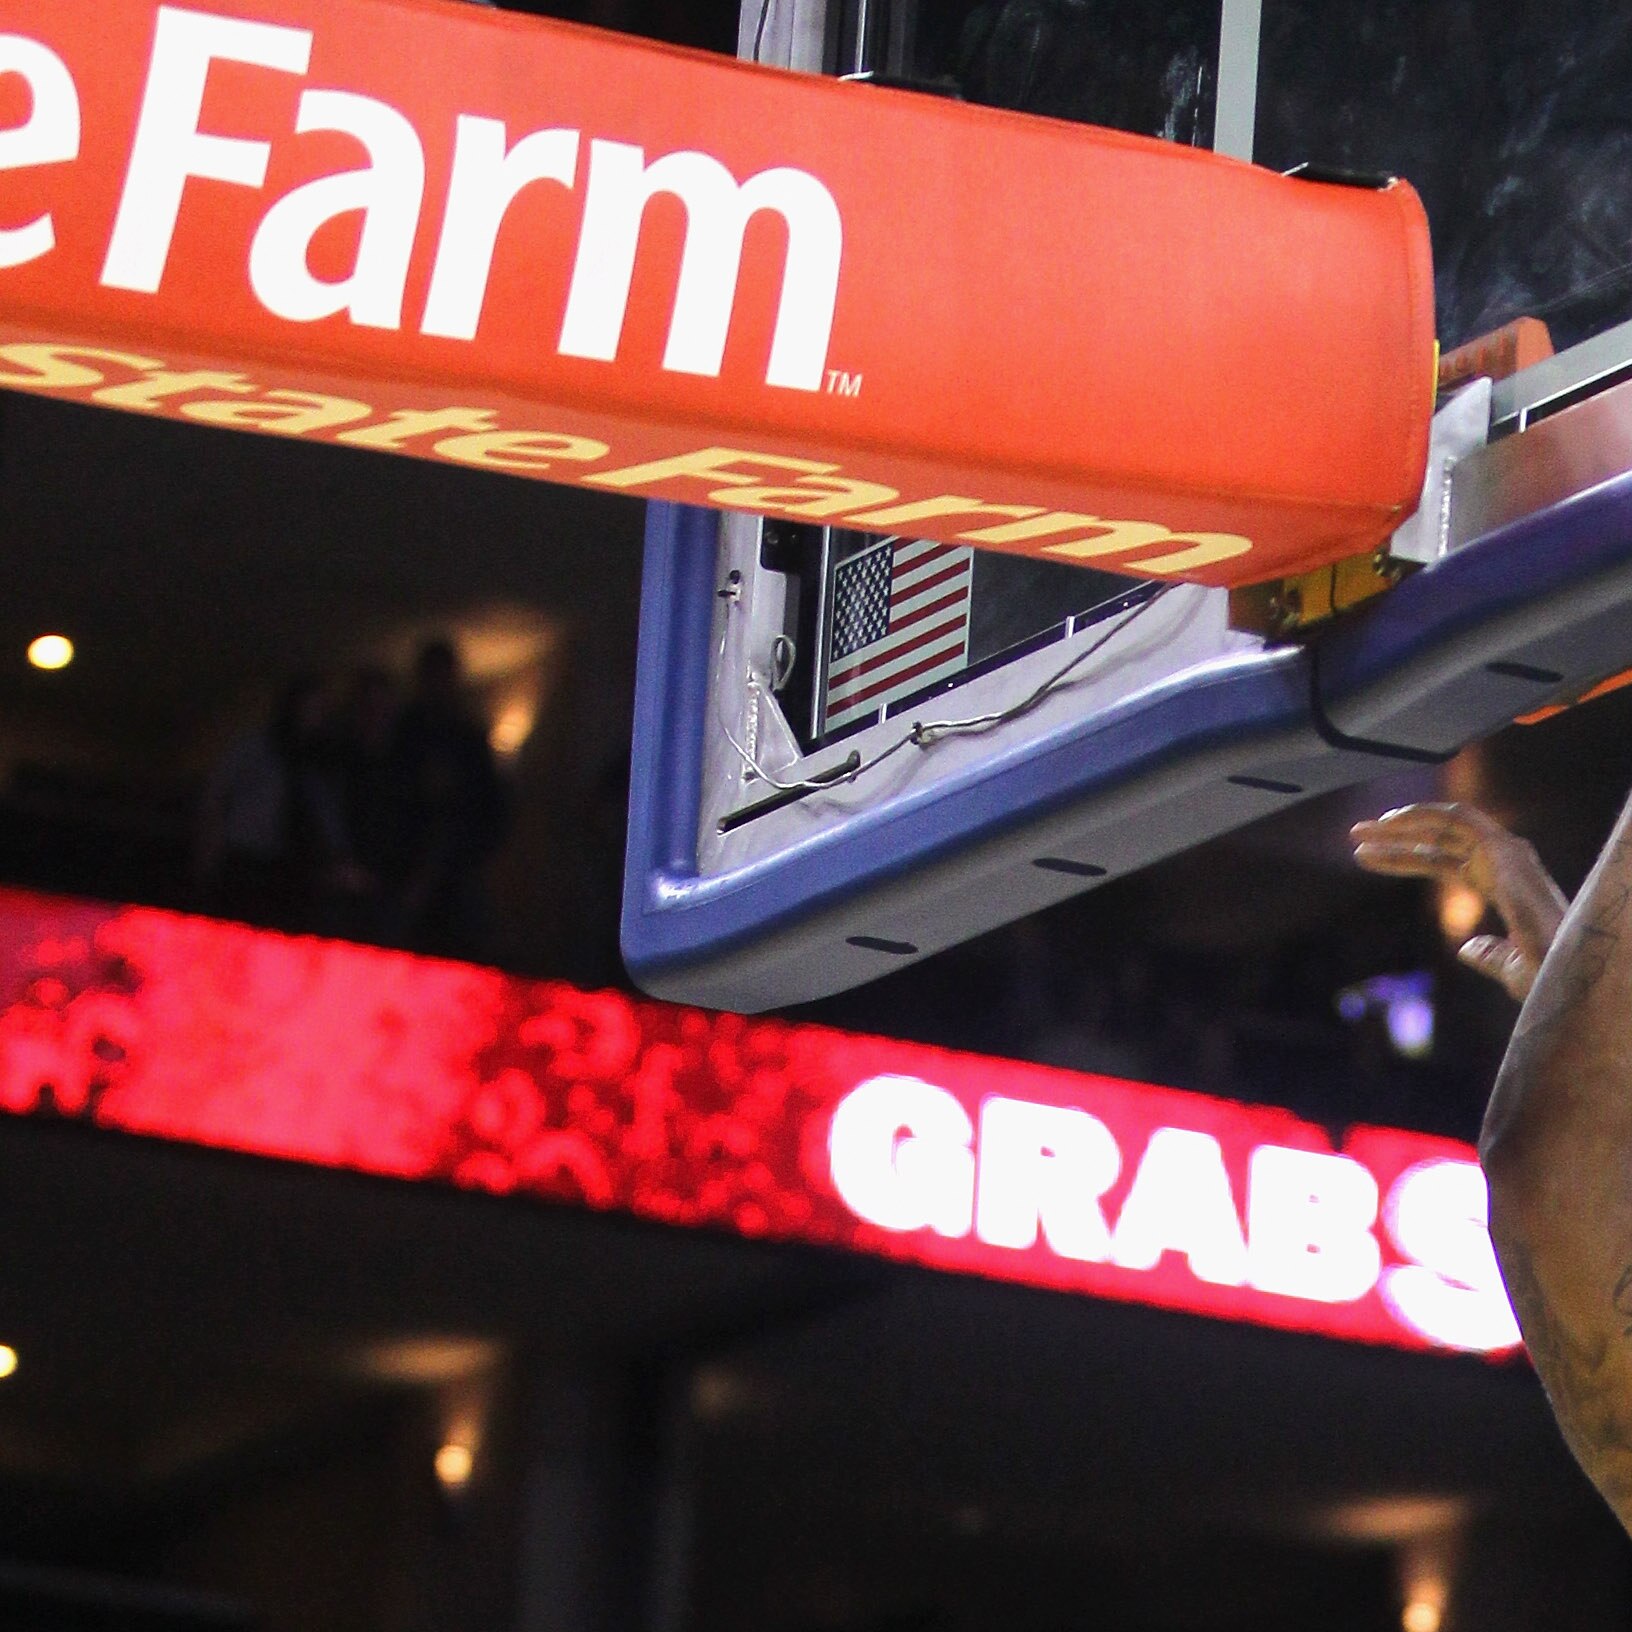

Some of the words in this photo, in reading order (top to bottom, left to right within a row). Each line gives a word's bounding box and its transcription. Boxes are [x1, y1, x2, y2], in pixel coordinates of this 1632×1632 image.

[99, 6, 844, 393] Farm
[0, 342, 610, 467] State
[582, 445, 1253, 574] Farm
[829, 1074, 1526, 1352] GRABS
